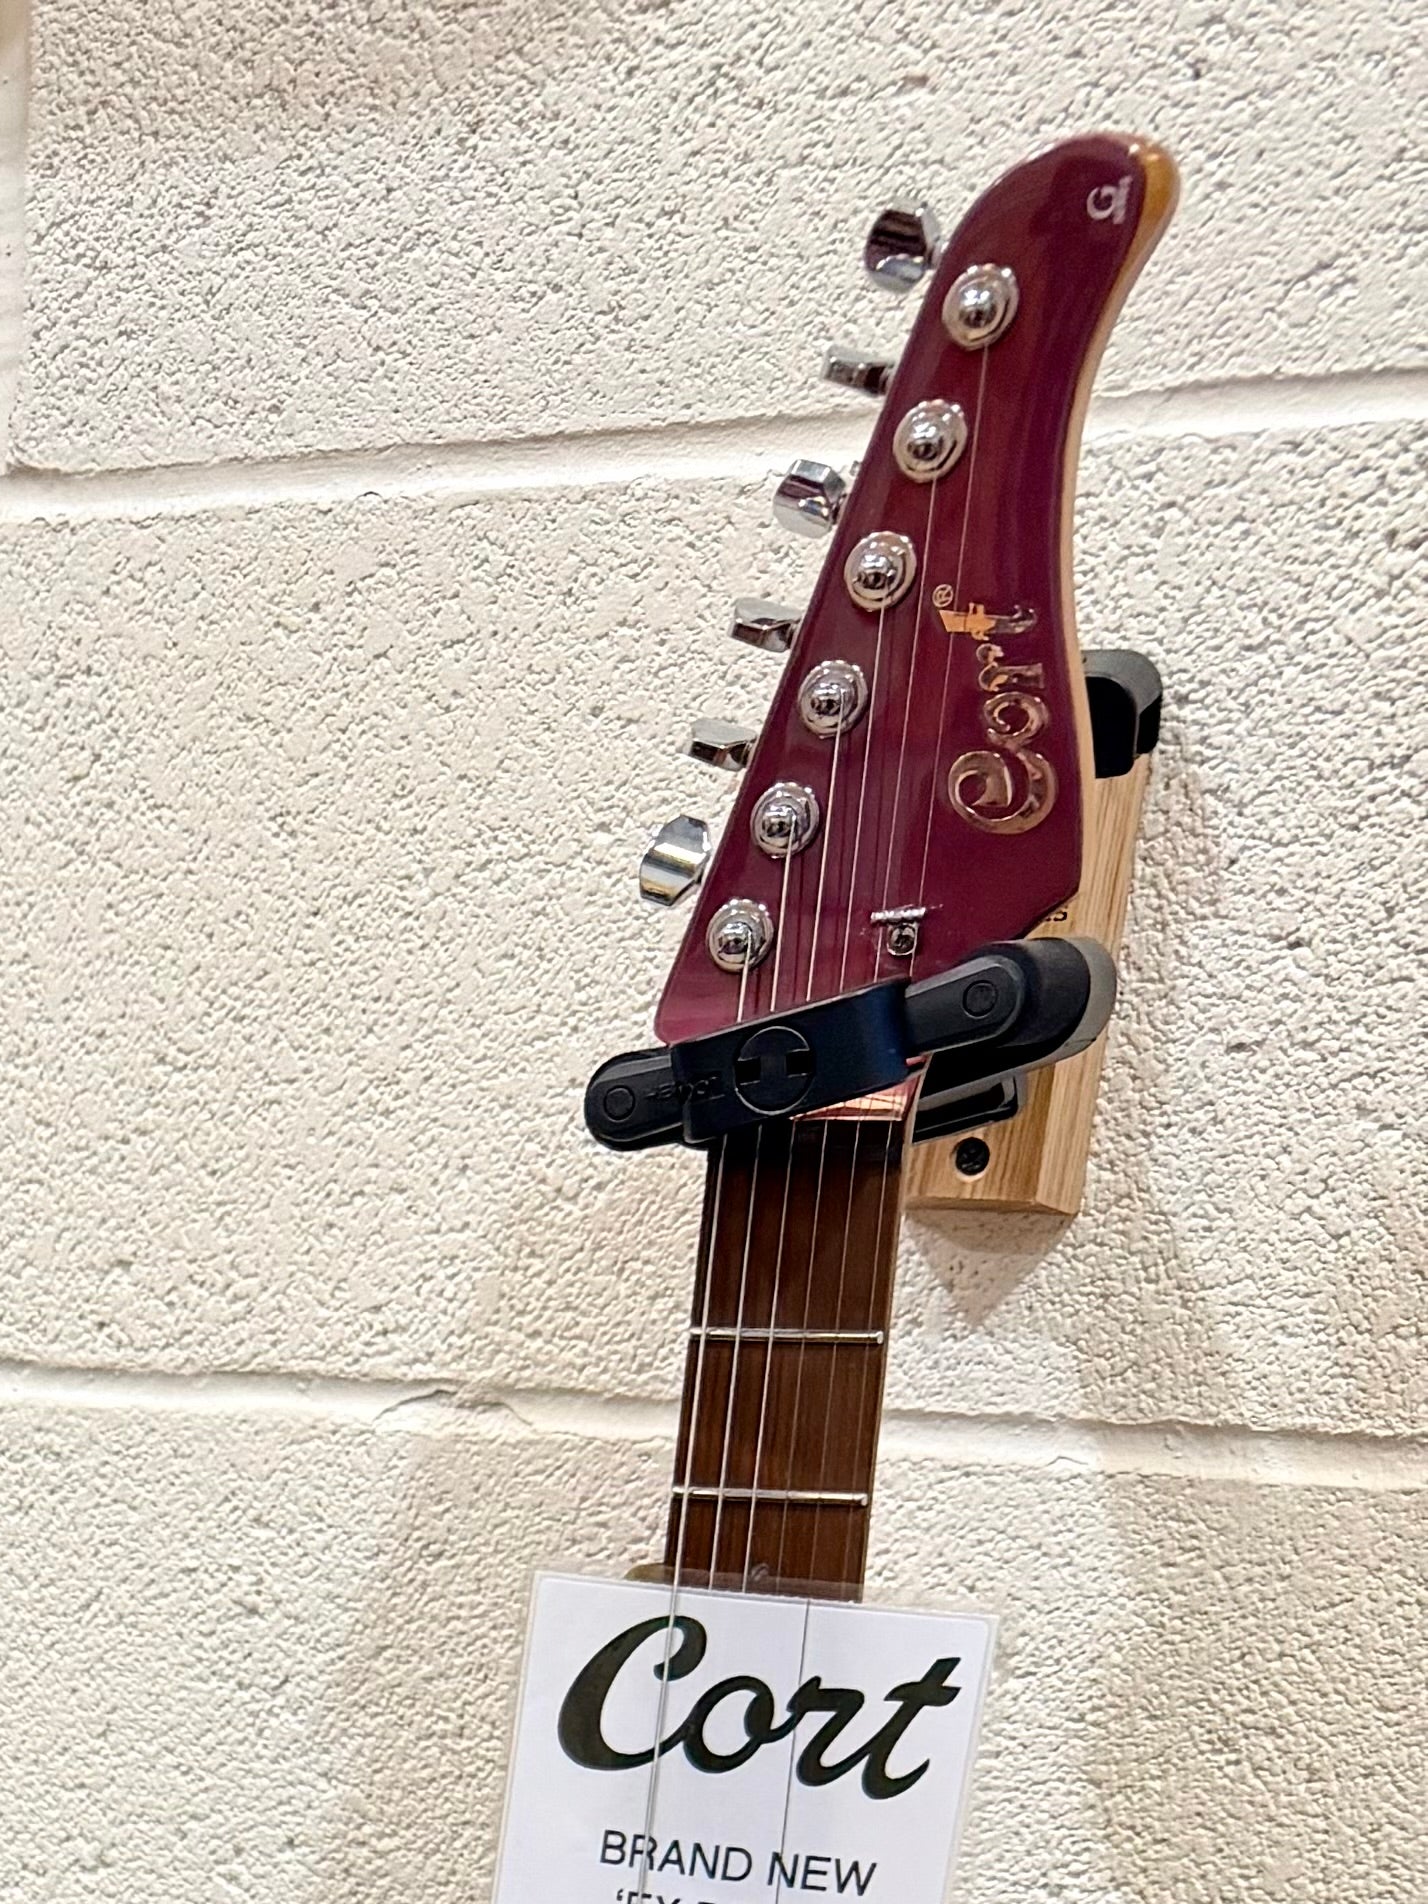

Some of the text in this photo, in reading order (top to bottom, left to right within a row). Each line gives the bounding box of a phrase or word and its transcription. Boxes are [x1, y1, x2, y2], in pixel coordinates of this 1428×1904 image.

[558, 1615, 961, 1799] Cort
[600, 1830, 876, 1896] BRAND NEW
